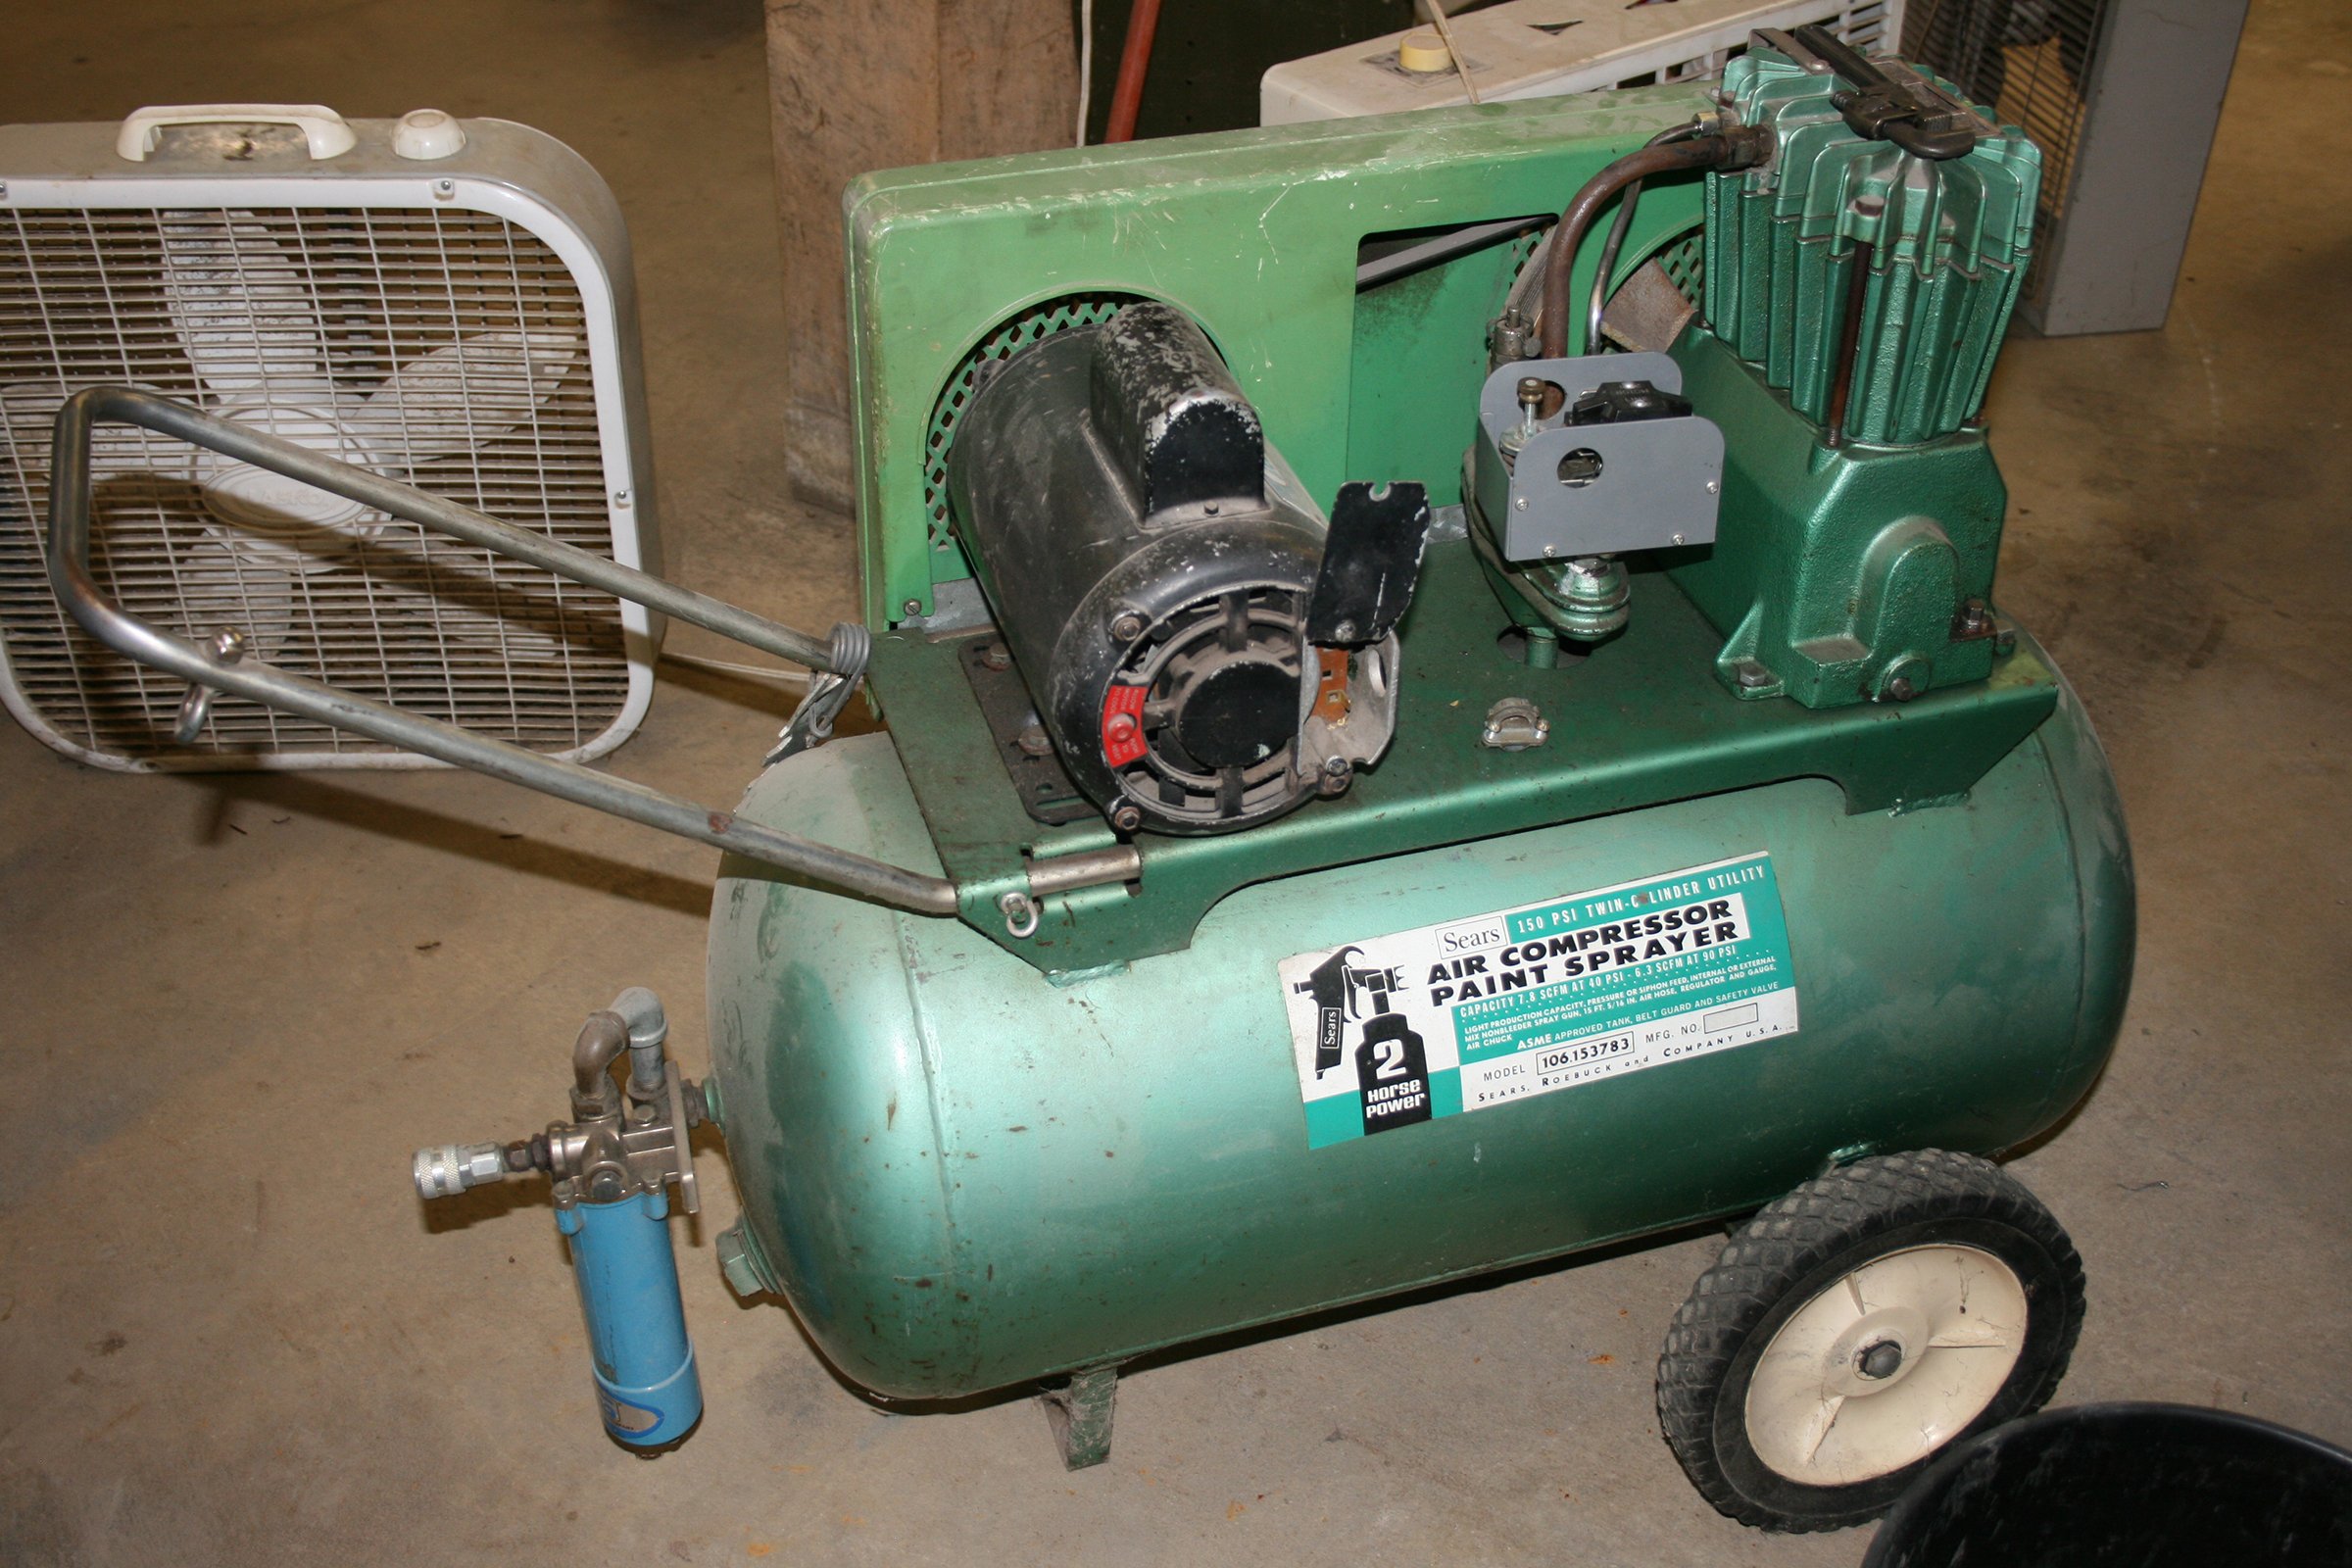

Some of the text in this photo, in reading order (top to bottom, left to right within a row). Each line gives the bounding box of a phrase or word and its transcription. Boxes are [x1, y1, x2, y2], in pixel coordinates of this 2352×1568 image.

[1517, 865, 1764, 933] 150 PSI TWIN-CLINDER UTILITY
[1427, 900, 1733, 985] AIR COMPRESSOR
[1430, 921, 1739, 1006] PAINT SPRAYER
[1444, 927, 1500, 953] Sears
[1460, 996, 1514, 1017] CAPACITY
[1518, 992, 1536, 1004] 7.8
[1540, 985, 1568, 1000] SCFM
[1572, 979, 1585, 992] AT
[1589, 977, 1602, 990] 40
[1605, 971, 1624, 985] PSI
[1635, 964, 1652, 977] 6.3
[1655, 956, 1684, 972] SCFM
[1687, 954, 1699, 965] AT
[1702, 950, 1715, 961] 90
[1718, 945, 1737, 958] PSI
[1464, 1021, 1490, 1034] LIGHT
[1490, 1010, 1543, 1028] PRODUCTION
[1588, 992, 1625, 1005] PRESSURE
[1627, 988, 1638, 997] OR
[1639, 982, 1667, 994] SIPHON
[1690, 968, 1727, 981] INTERNAL
[1728, 964, 1739, 973] OR
[1740, 956, 1776, 970] EXTERNAL
[1464, 1033, 1480, 1043] MIX
[1482, 1020, 1532, 1039] NONBLEEDER
[1534, 1014, 1559, 1026] SPRAY
[1583, 1005, 1592, 1014] 15
[1593, 1004, 1605, 1012] FT.
[1639, 993, 1652, 1002] AIR
[1680, 976, 1726, 993] REGULATOR
[1729, 971, 1744, 981] AND
[1324, 1011, 1337, 1045] Sears
[1466, 1034, 1512, 1051] AIR CHUCK
[1517, 1034, 1552, 1051] ASME
[1554, 1023, 1603, 1041] APPROVED
[1635, 1009, 1657, 1022] BELT
[1660, 1002, 1691, 1016] GUARD
[1694, 997, 1713, 1008] AND
[1716, 989, 1748, 1003] SAFETY
[1750, 981, 1779, 995] VALVE
[1373, 1038, 1407, 1080] 2
[1483, 1023, 1700, 1082] MODEL 106.153783 MFG. NO.
[1542, 1064, 1612, 1087] ROEBUCK
[1624, 1054, 1648, 1067] and
[1663, 1035, 1734, 1057] COMPANY
